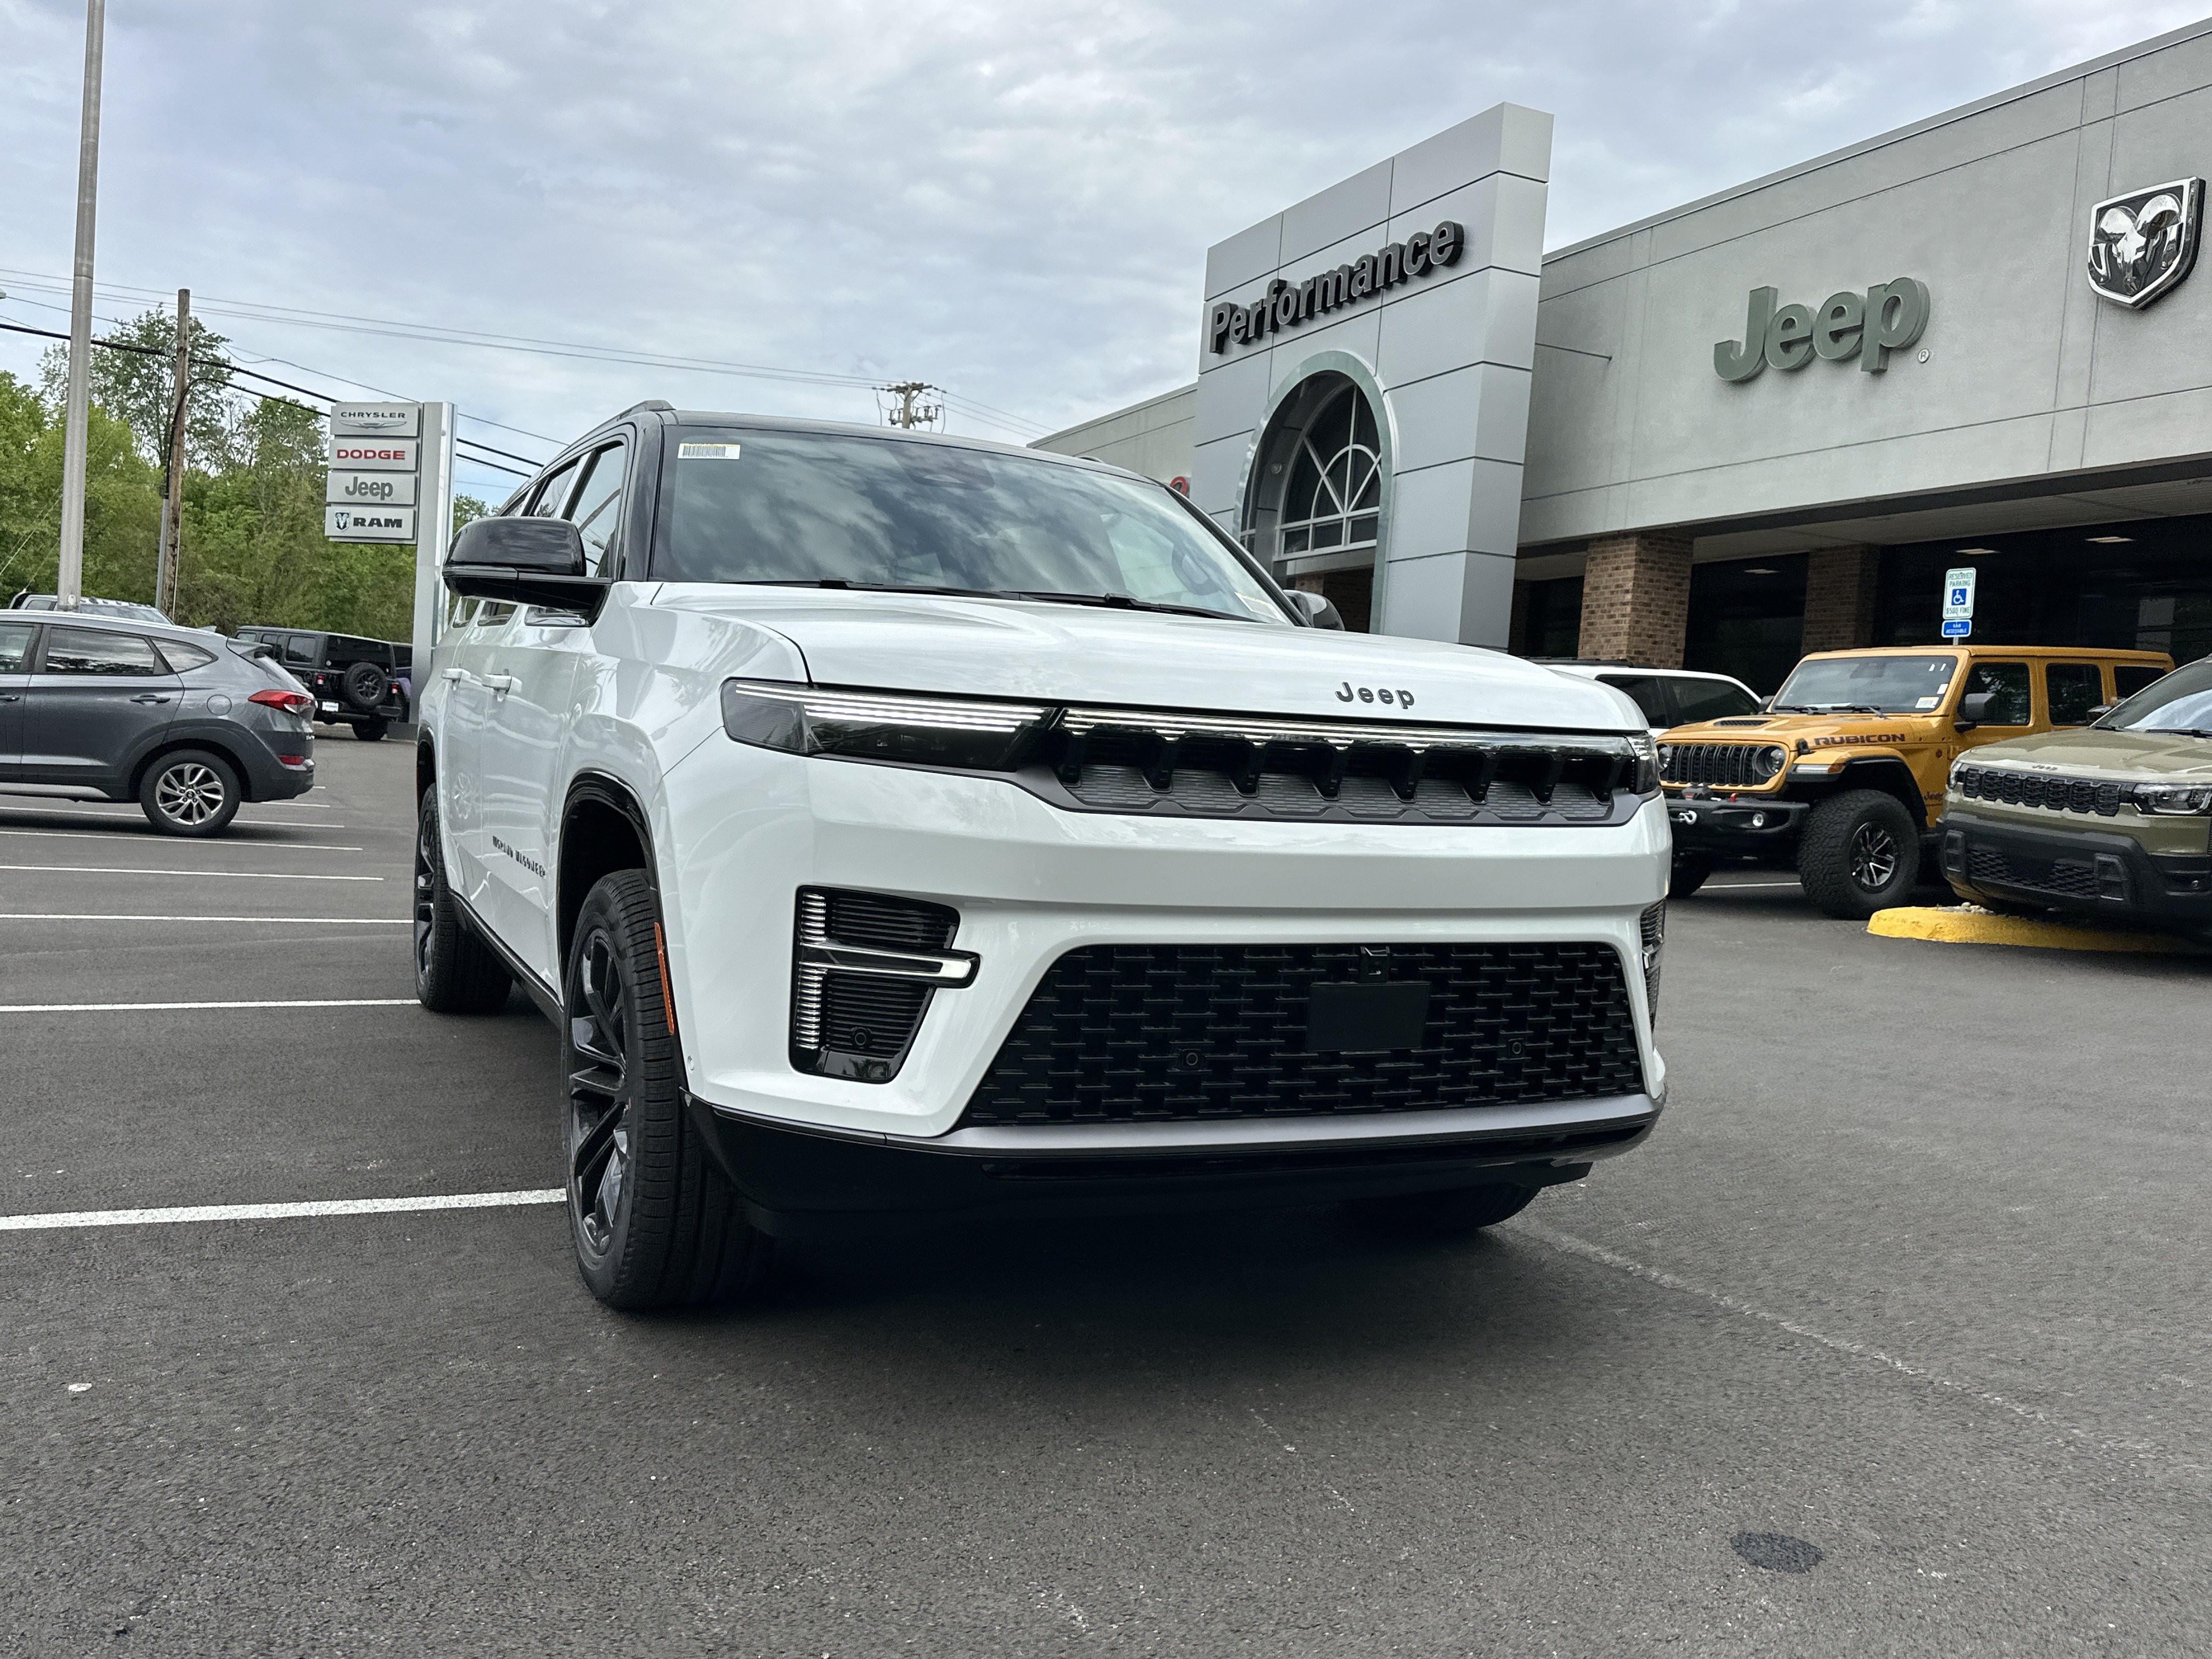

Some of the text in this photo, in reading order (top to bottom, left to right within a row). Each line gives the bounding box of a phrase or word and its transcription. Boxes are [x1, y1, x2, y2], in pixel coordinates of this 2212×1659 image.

[1209, 220, 1464, 354] Performance
[1713, 276, 1931, 382] Jeep
[337, 449, 406, 460] DODGE
[345, 476, 393, 500] Jeep
[353, 517, 403, 528] RAM
[1334, 681, 1415, 709] Jeep
[1814, 733, 1905, 746] RUBICON
